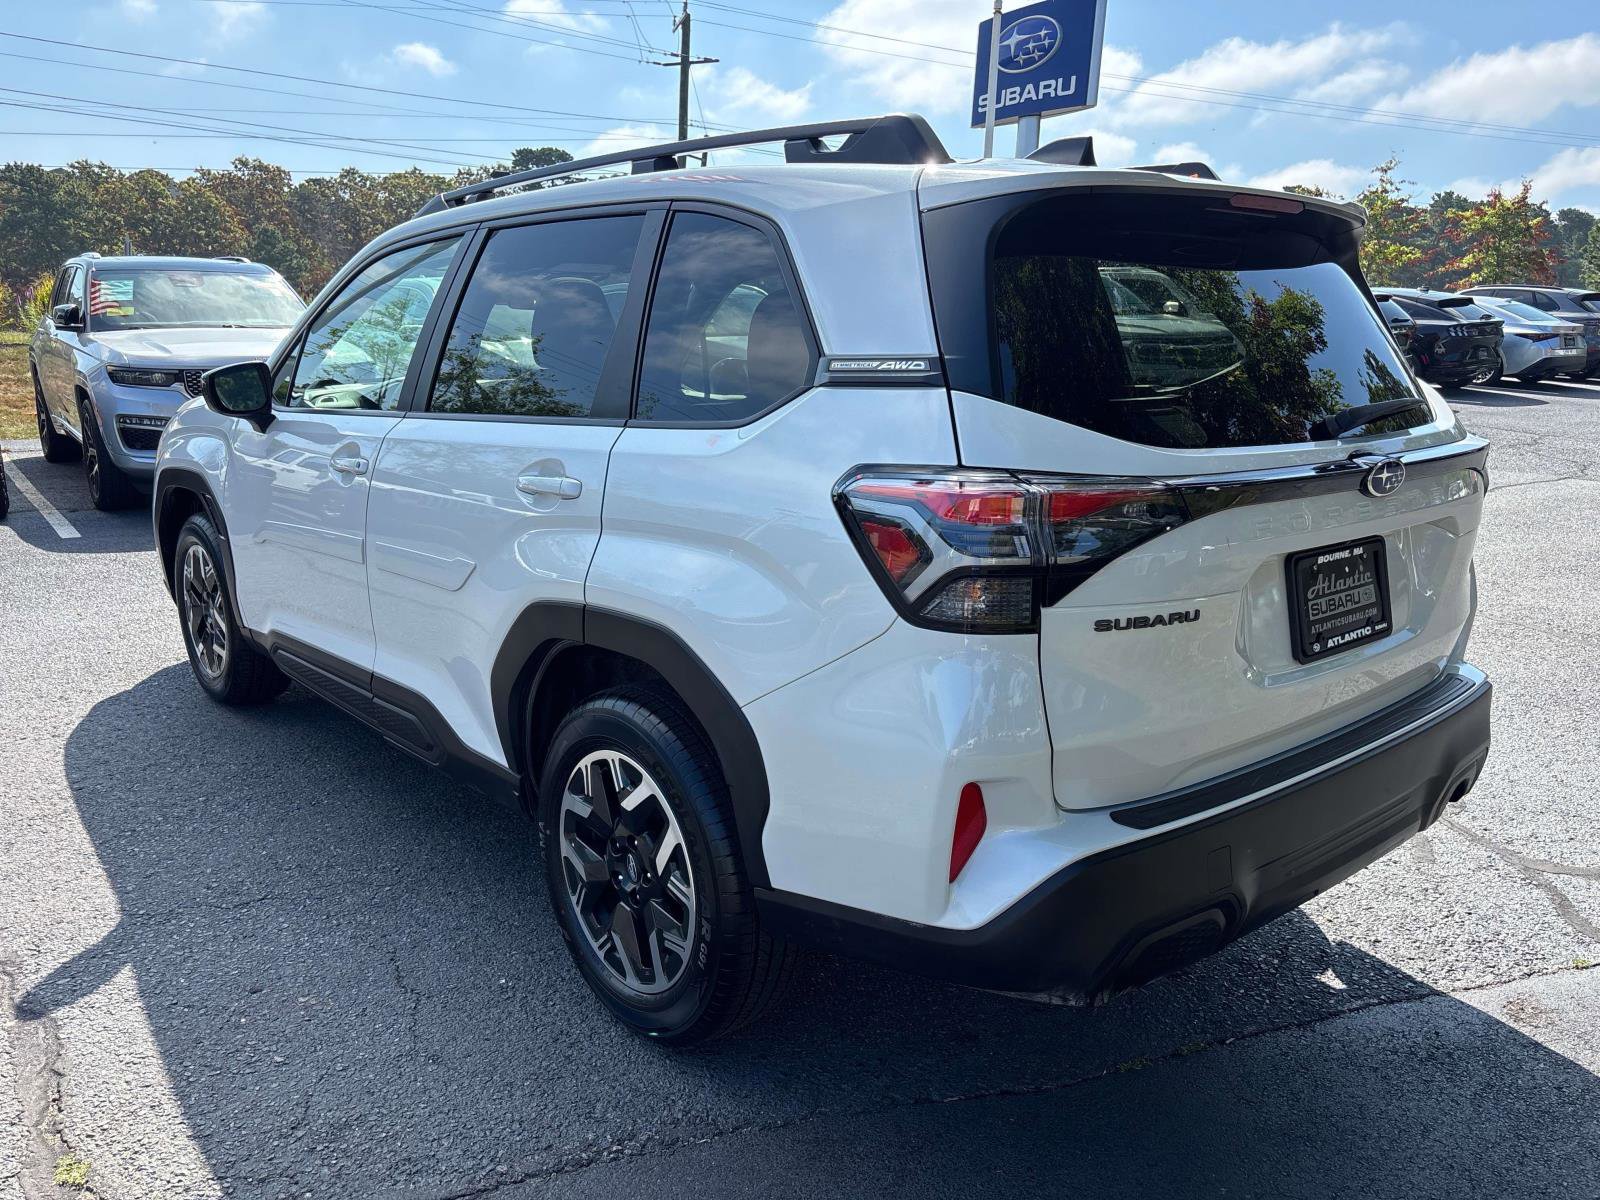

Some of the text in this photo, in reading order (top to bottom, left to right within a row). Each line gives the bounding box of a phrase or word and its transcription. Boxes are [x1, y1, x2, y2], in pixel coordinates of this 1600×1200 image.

[978, 75, 1077, 113] SUBARU
[877, 361, 925, 370] AWD
[1353, 547, 1363, 555] MA
[1307, 564, 1374, 600] Atlantic
[1310, 591, 1361, 618] SUBARU
[1094, 608, 1201, 632] SUBARU
[1311, 607, 1377, 634] ATLANTICSUBARU.COM
[1327, 626, 1371, 648] ATLANTIC
